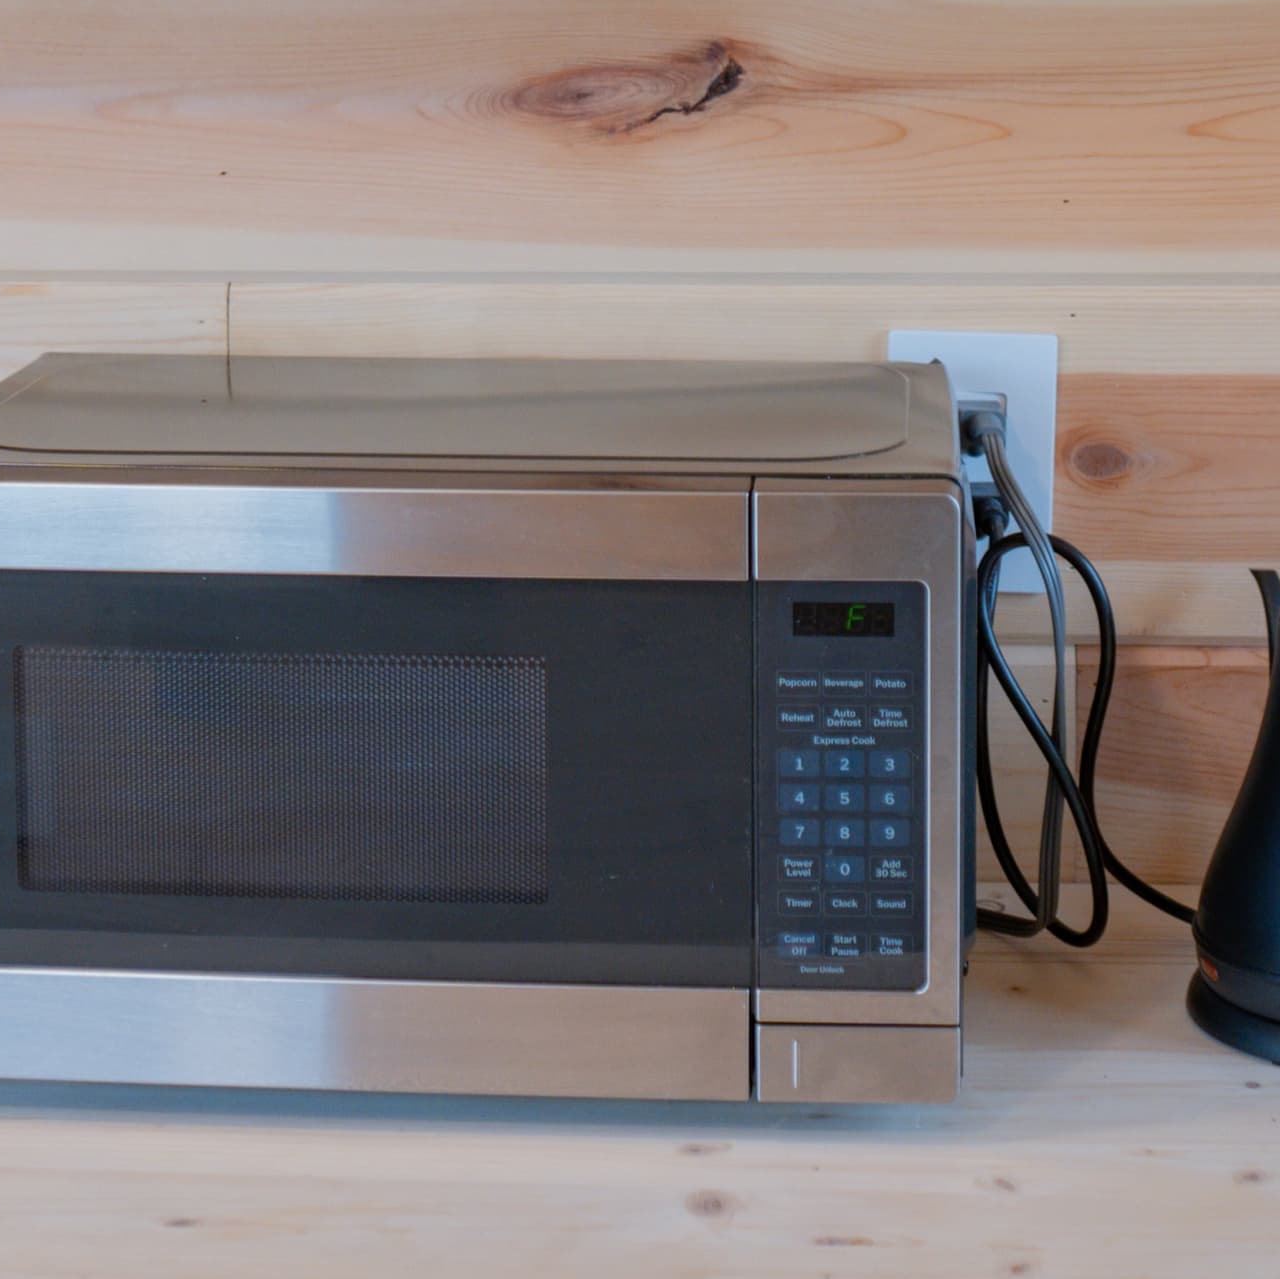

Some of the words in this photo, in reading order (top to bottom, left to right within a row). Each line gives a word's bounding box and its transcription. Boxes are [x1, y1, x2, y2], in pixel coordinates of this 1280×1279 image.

[779, 677, 817, 689] Popcorn
[824, 678, 864, 689] Beverage
[875, 678, 907, 689] Potato
[781, 712, 815, 723] Reheat
[833, 708, 856, 719] Auto
[880, 709, 902, 718] Time
[826, 718, 862, 728] Defrost
[873, 718, 908, 728] Defrost
[813, 735, 850, 746] Express
[851, 735, 876, 745] Cook
[795, 757, 804, 771] 1
[839, 757, 850, 771] 2
[884, 757, 895, 772] 3
[794, 791, 805, 805] 4
[839, 791, 850, 805] 5
[884, 792, 895, 806] 6
[795, 825, 805, 839] 7
[839, 826, 850, 840] 8
[884, 826, 895, 840] 9
[784, 858, 813, 868] Power
[881, 859, 901, 869] Add
[786, 868, 812, 877] Level
[839, 863, 851, 876] 0
[875, 868, 889, 878] 30
[890, 868, 908, 878] Sec
[785, 898, 813, 908] Timer
[832, 898, 858, 908] Clock
[877, 899, 907, 909] Sound
[784, 934, 816, 944] Cancel
[833, 935, 857, 944] Start
[880, 936, 903, 946] Time
[791, 946, 807, 956] Off
[831, 947, 859, 957] Pause
[879, 947, 904, 956] Cook
